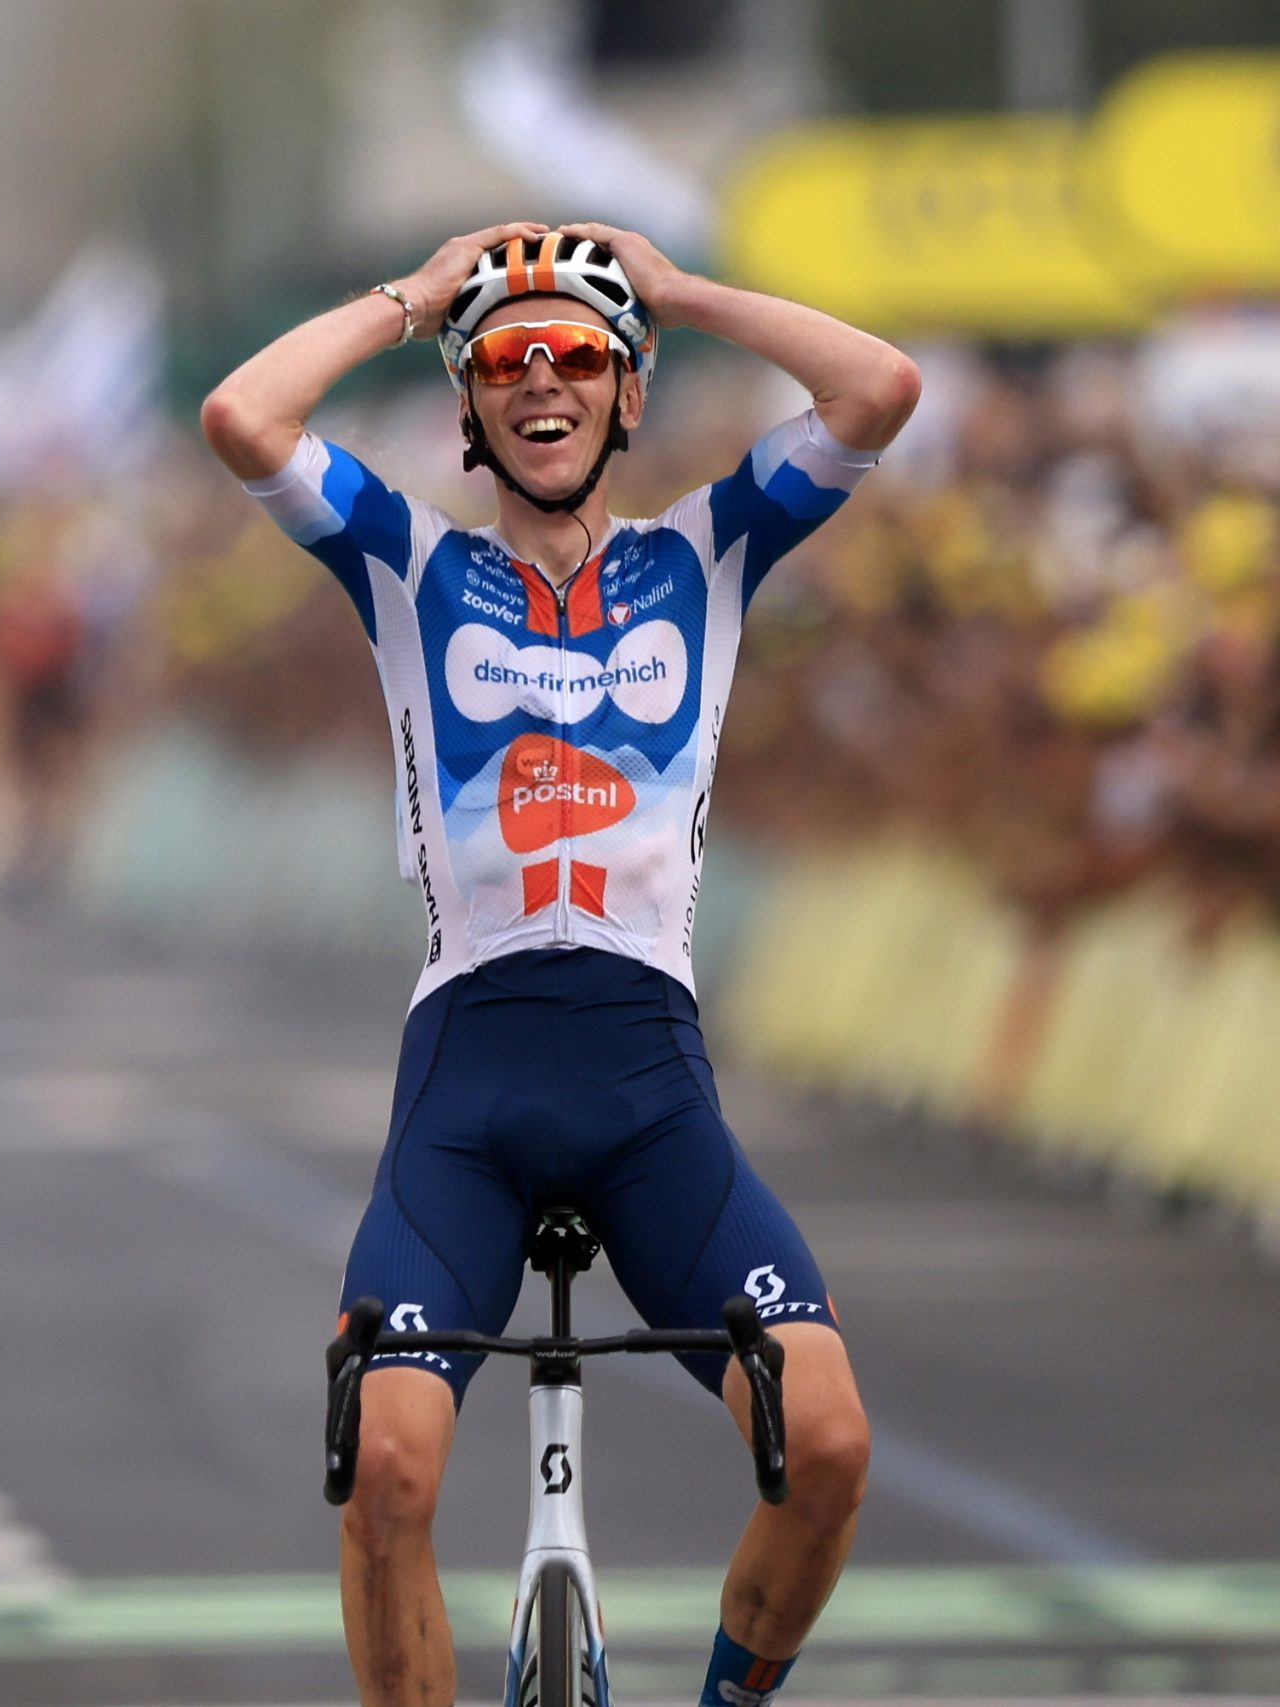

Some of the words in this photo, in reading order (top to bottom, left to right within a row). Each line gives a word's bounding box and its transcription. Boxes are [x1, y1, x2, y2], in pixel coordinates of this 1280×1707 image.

[461, 588, 523, 626] zoover
[632, 575, 674, 614] Nalini
[474, 656, 667, 694] dsm-firmenich
[400, 708, 423, 835] ANDERS
[513, 781, 618, 814] postnl
[417, 843, 440, 927] HANS
